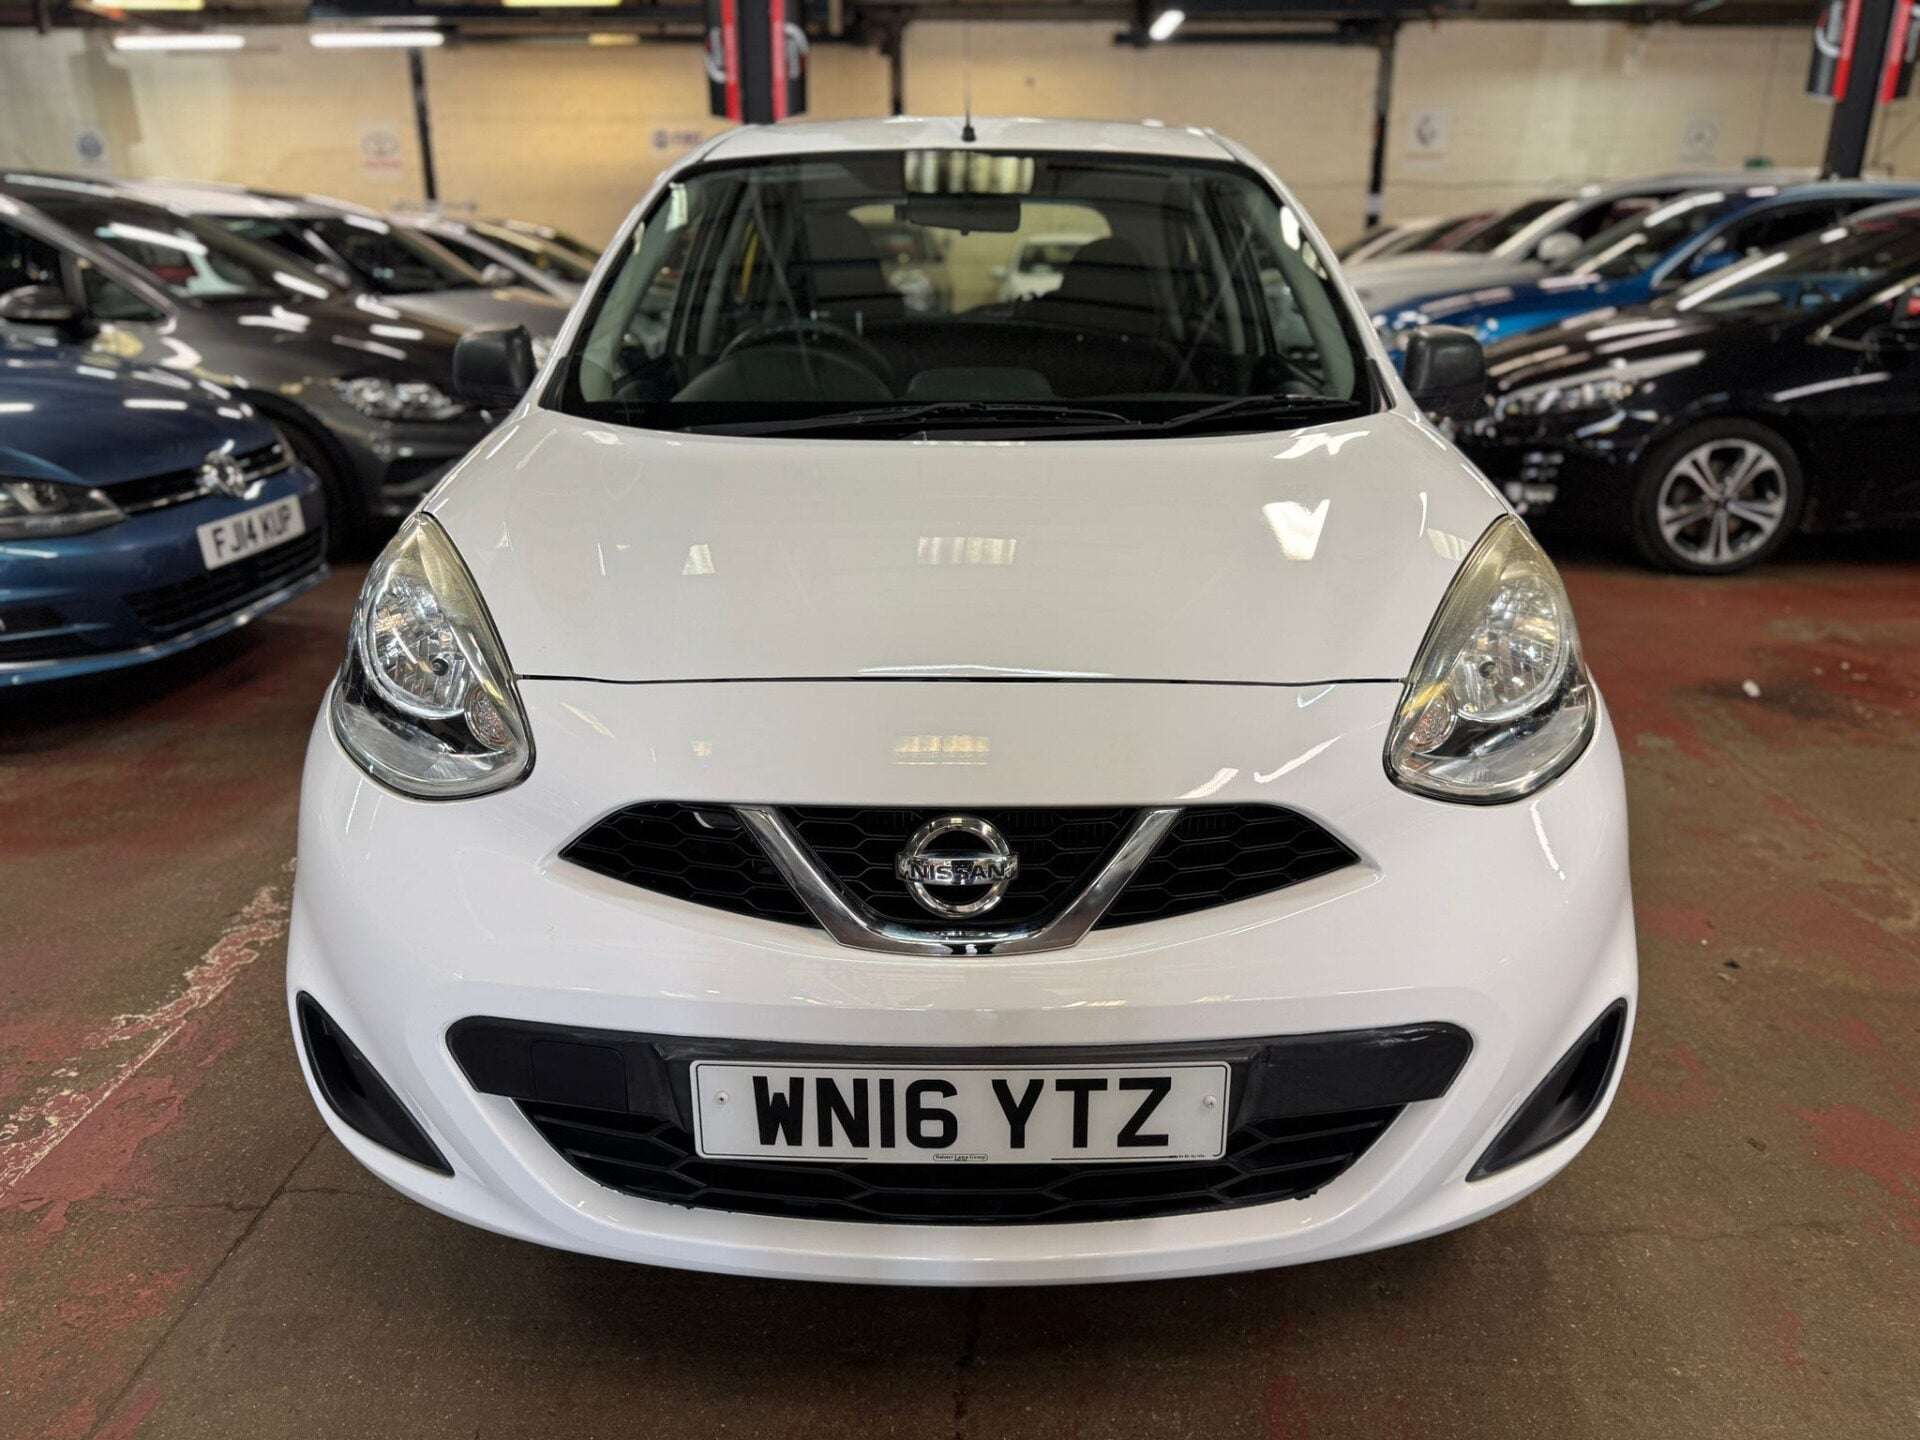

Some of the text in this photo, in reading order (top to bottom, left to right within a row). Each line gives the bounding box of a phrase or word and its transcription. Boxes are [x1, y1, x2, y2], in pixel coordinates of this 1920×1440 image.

[909, 859, 1006, 881] NISSAN
[752, 1075, 1172, 1149] WN16 YTZ
